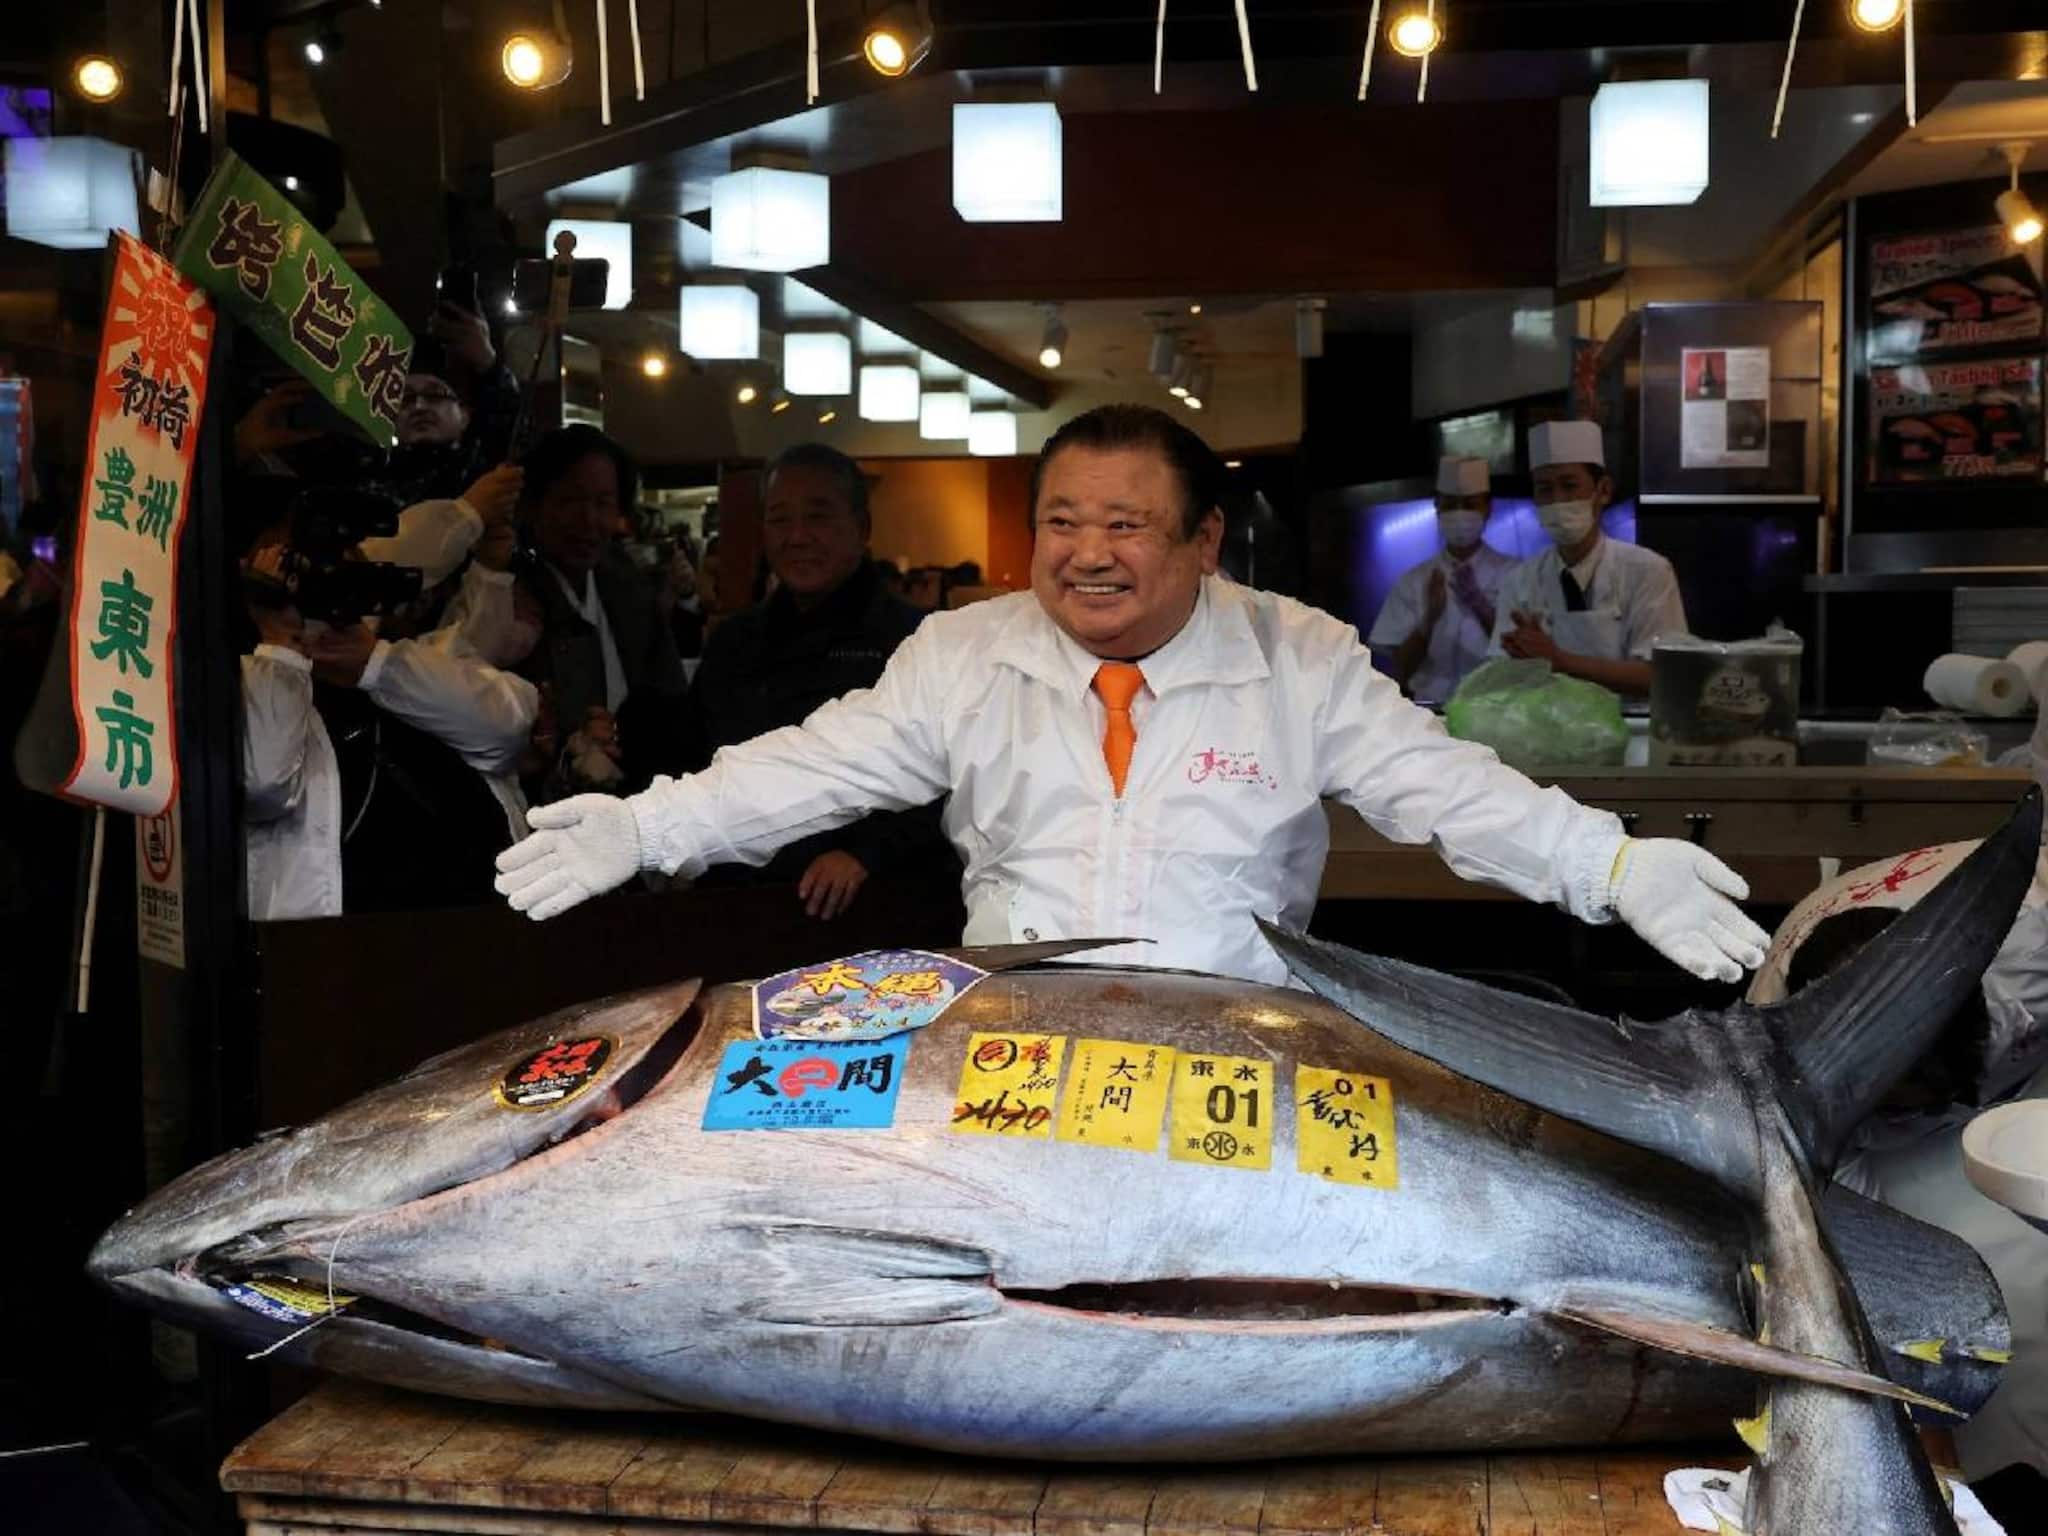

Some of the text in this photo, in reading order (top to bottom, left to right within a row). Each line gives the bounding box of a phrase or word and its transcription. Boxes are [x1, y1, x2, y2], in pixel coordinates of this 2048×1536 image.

[1099, 1055, 1139, 1113] 大間
[1206, 1084, 1259, 1128] 01
[1334, 1078, 1377, 1100] 01
